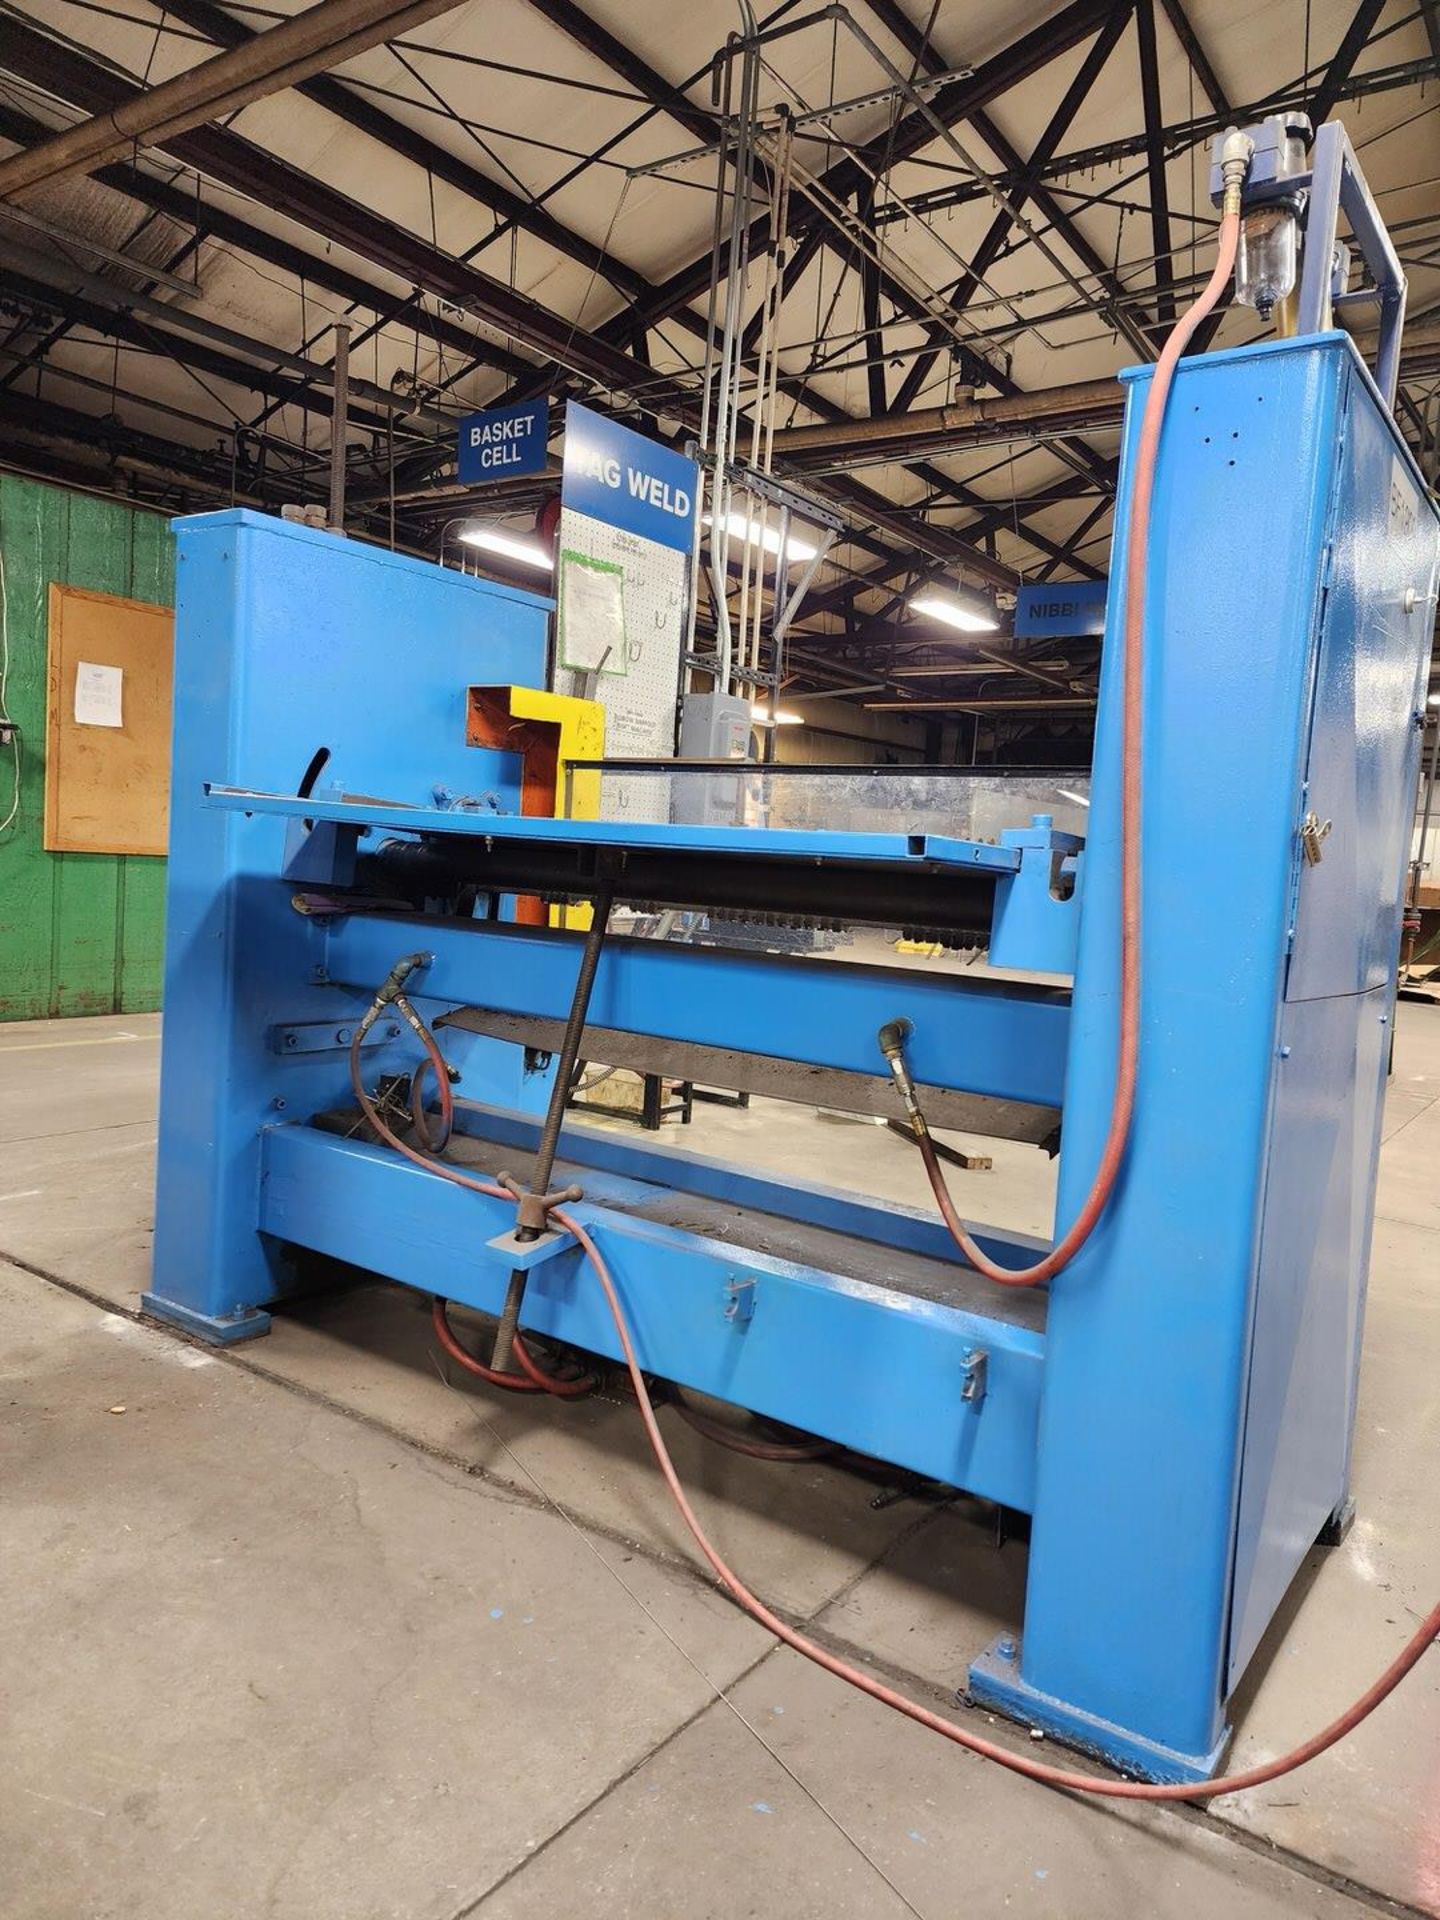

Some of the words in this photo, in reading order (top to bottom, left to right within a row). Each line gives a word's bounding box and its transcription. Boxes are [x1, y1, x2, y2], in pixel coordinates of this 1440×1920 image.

[471, 415, 534, 447] BASKET
[481, 443, 521, 468] CELL
[572, 446, 621, 489] AG
[628, 466, 690, 517] WELD
